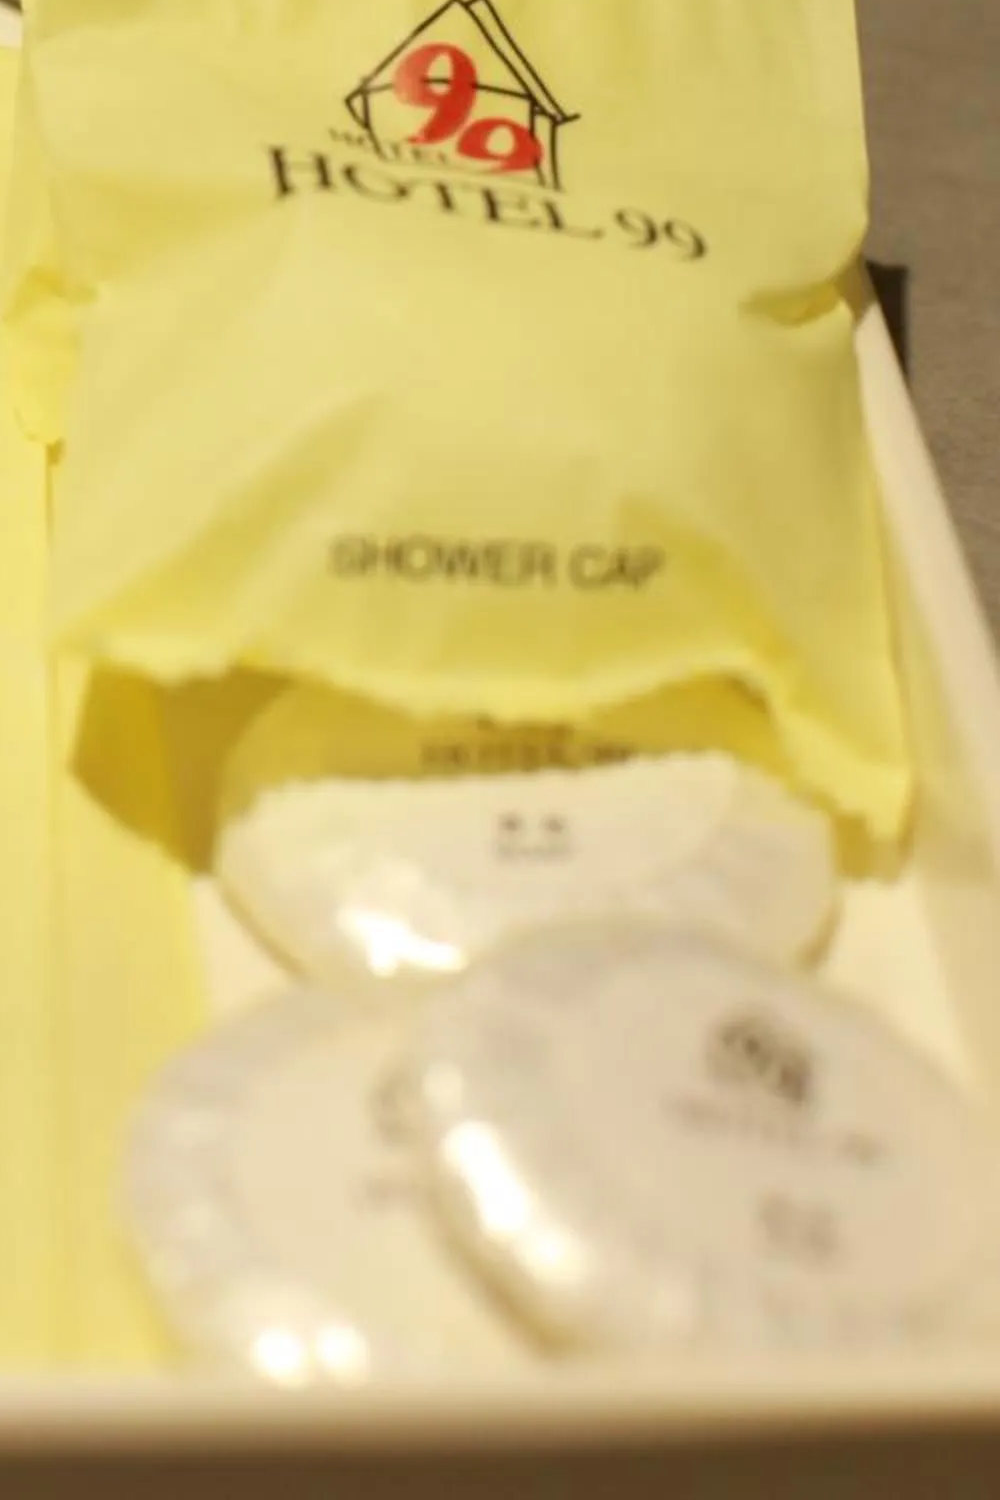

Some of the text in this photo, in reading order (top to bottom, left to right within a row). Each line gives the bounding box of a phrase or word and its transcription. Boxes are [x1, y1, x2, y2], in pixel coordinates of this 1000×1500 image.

[391, 41, 545, 175] 99
[266, 143, 707, 262] HOTEL 99
[329, 533, 666, 592] SHOWER CAP
